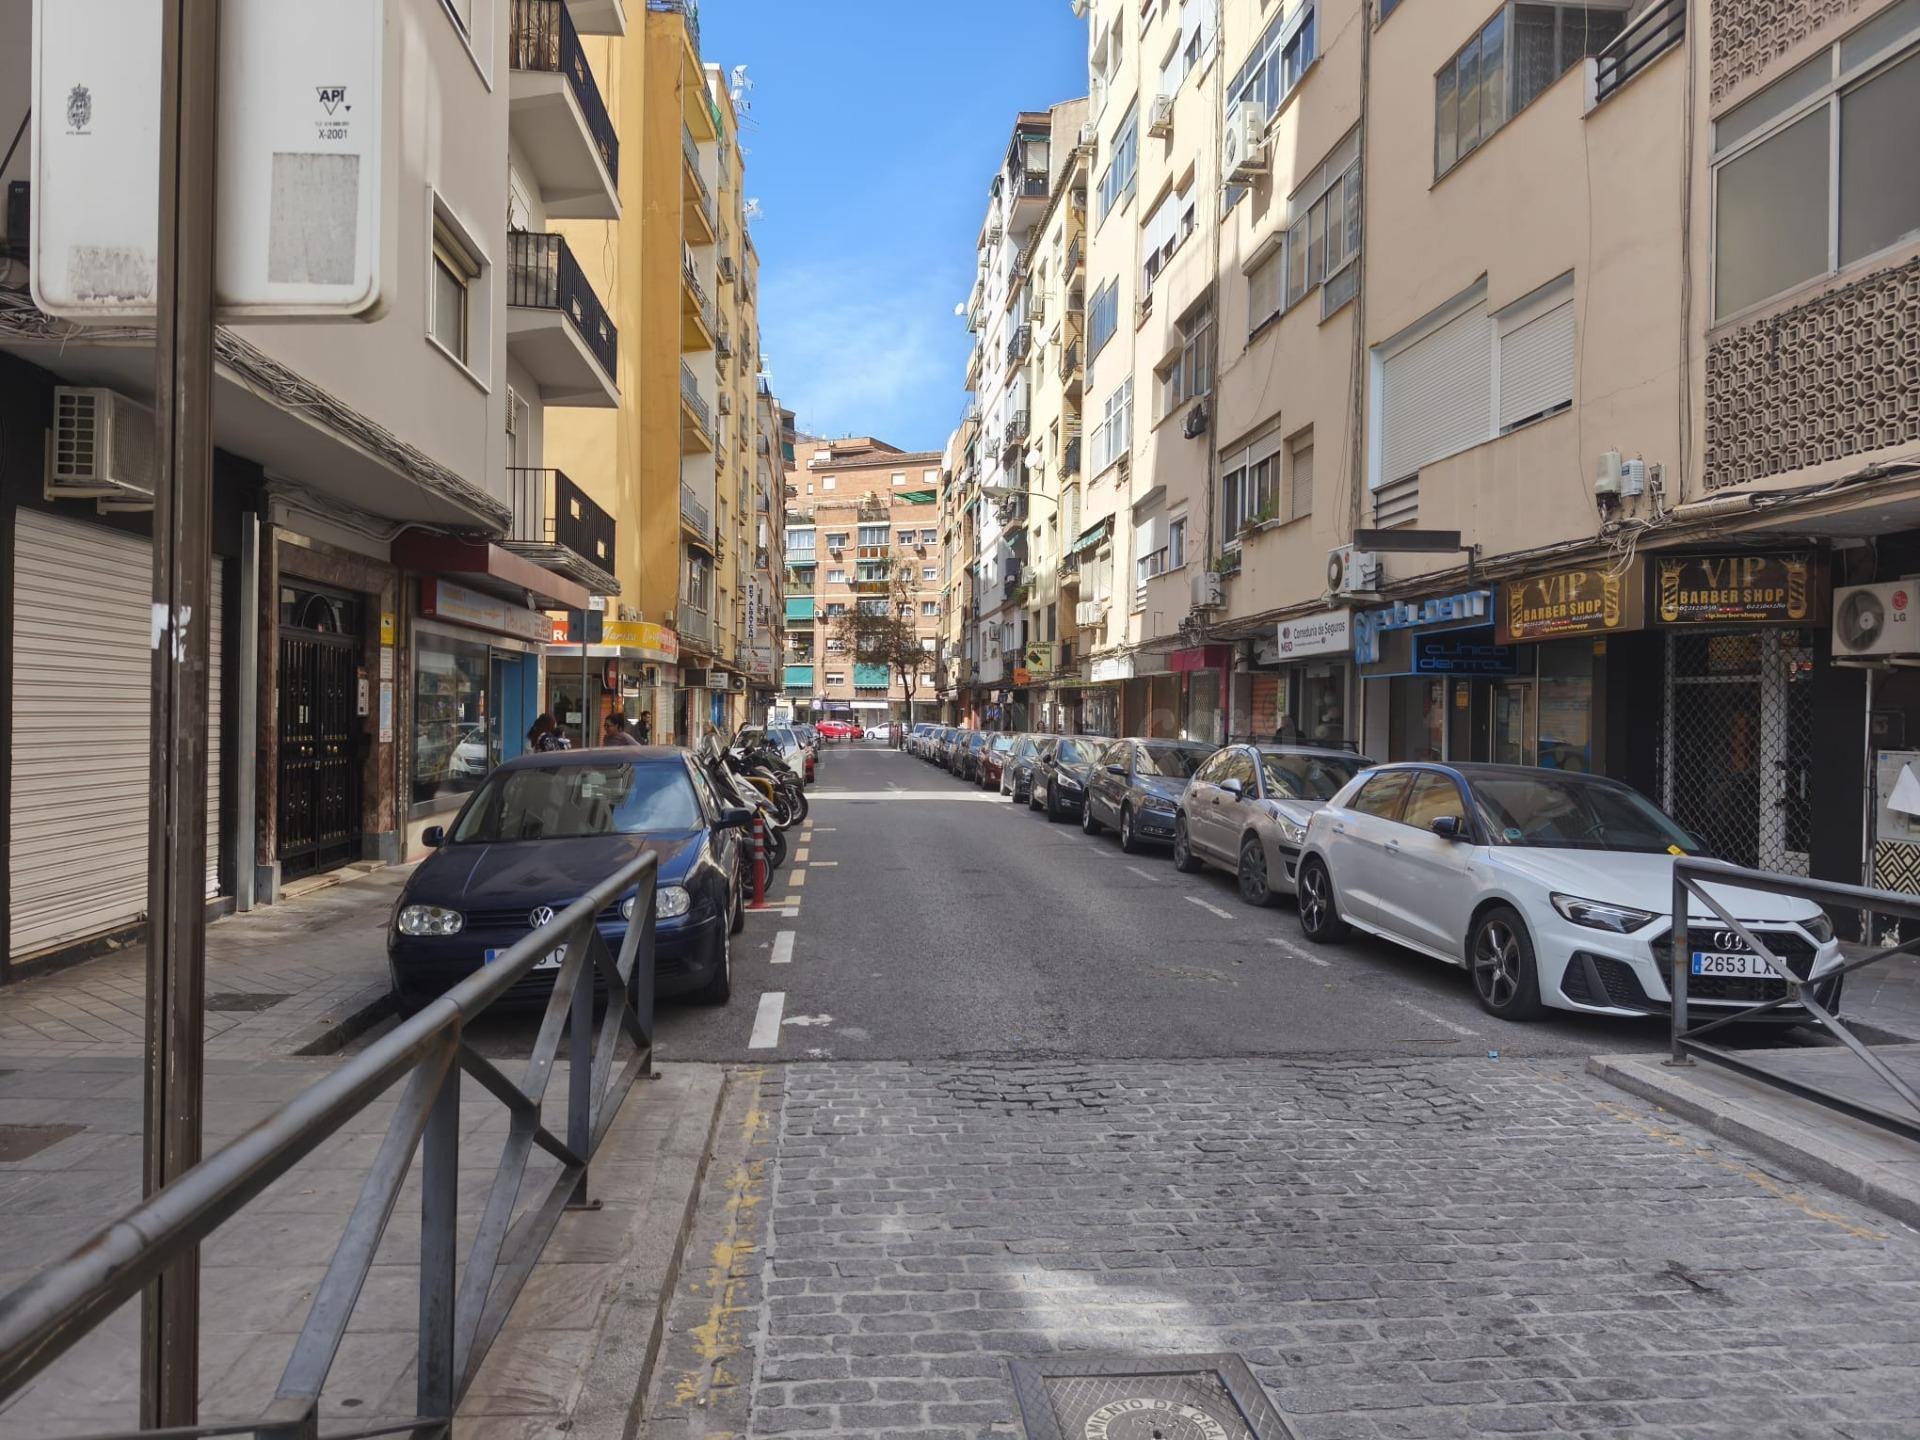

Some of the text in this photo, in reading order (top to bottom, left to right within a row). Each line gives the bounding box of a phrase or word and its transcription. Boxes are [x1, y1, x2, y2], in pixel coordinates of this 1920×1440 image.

[319, 89, 345, 103] API
[318, 128, 348, 140] X-2001
[1701, 557, 1766, 589] VIP
[1537, 572, 1587, 605] VIP
[1679, 588, 1785, 604] BARBER SHOP
[1523, 603, 1566, 622] BARBER
[1570, 599, 1602, 616] SHOP
[1893, 613, 1906, 622] LG
[1703, 955, 1784, 976] 2653 LX
[1153, 1398, 1185, 1413] DE
